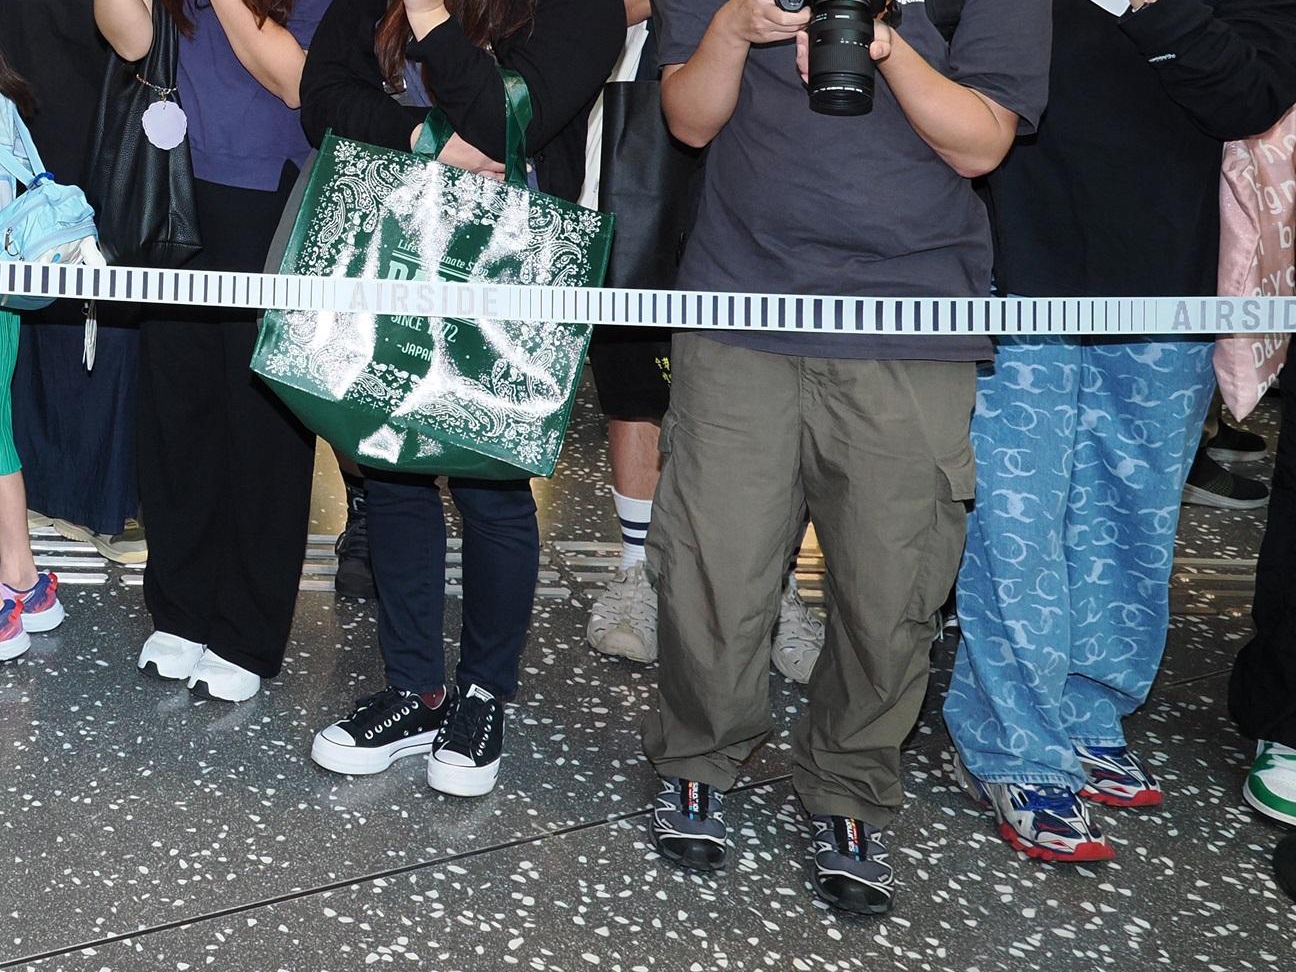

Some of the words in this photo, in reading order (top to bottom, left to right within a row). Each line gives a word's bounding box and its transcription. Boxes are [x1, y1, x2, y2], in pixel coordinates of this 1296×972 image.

[466, 260, 490, 277] Sop
[348, 281, 500, 317] AIRSIDE
[1171, 300, 1296, 331] AIRSID
